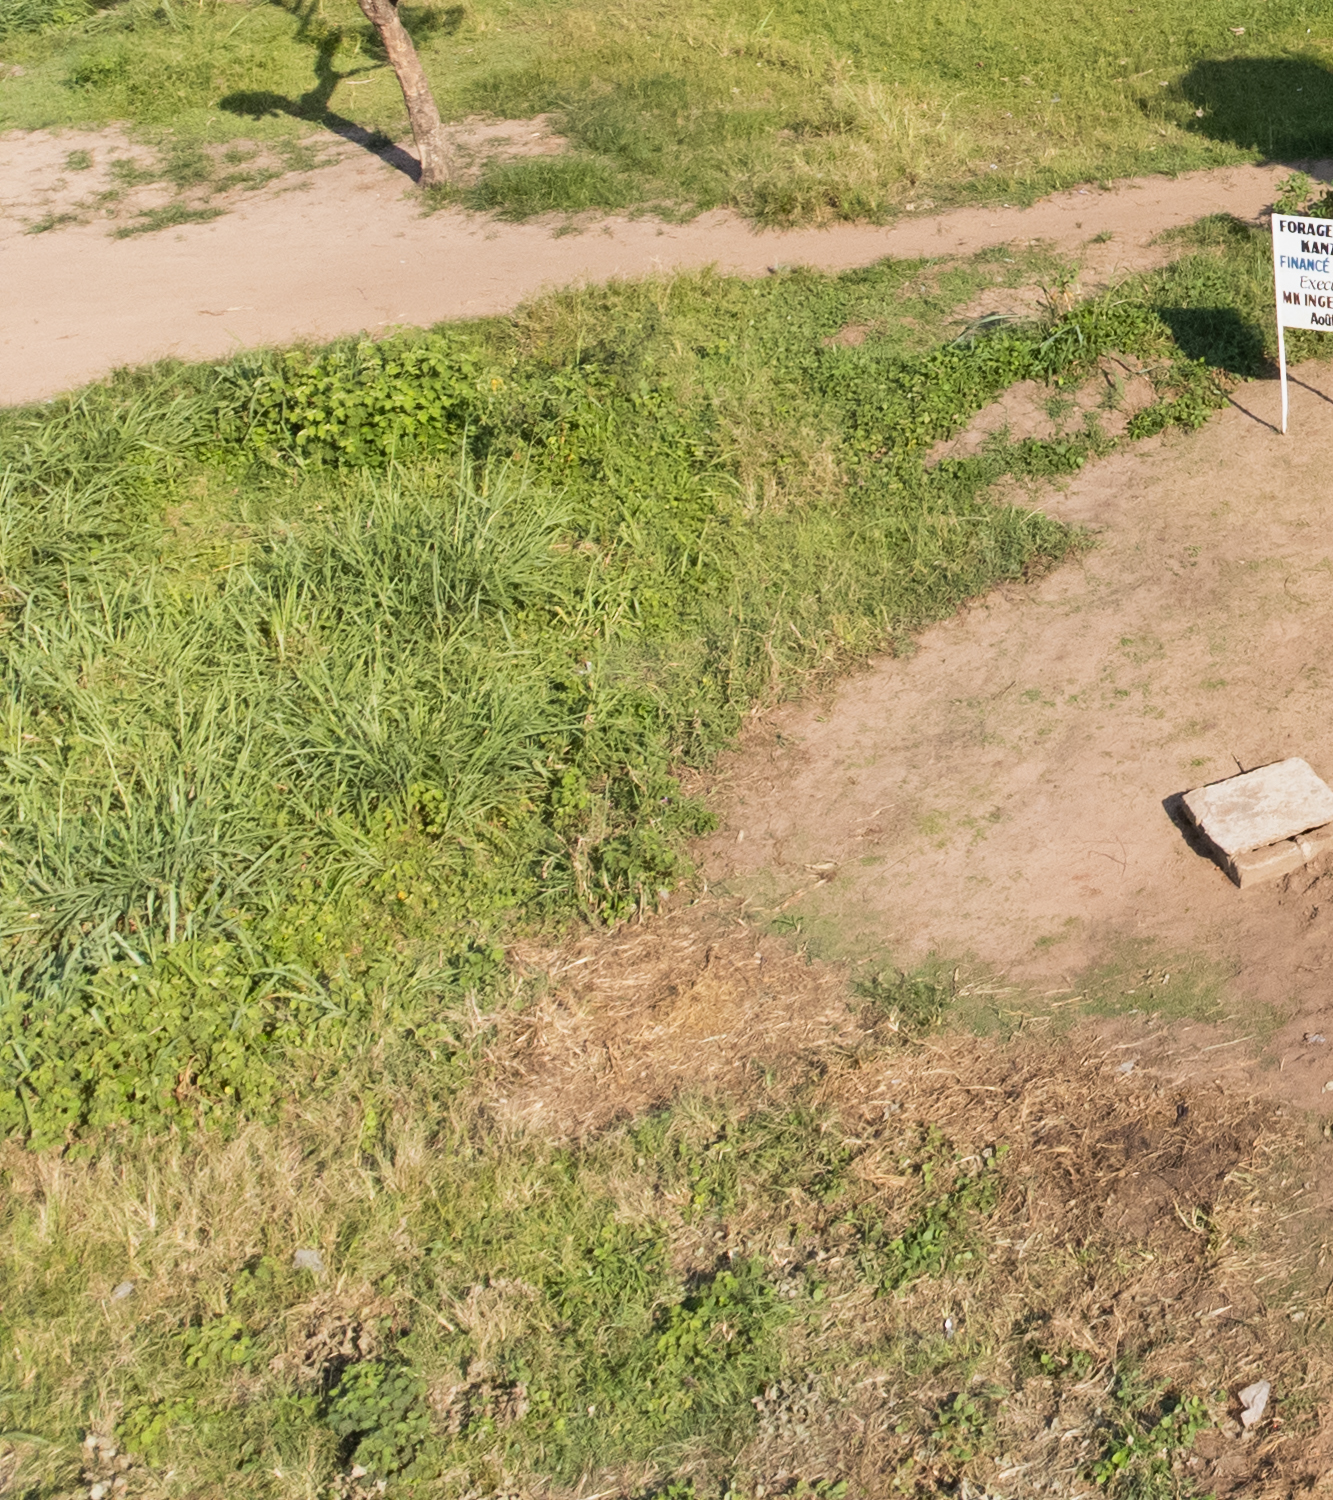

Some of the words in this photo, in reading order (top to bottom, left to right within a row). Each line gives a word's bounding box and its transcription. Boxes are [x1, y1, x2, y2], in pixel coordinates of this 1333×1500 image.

[1280, 220, 1333, 238] FORAGE
[1280, 255, 1330, 273] FINANCÉ
[1283, 290, 1301, 306] MK
